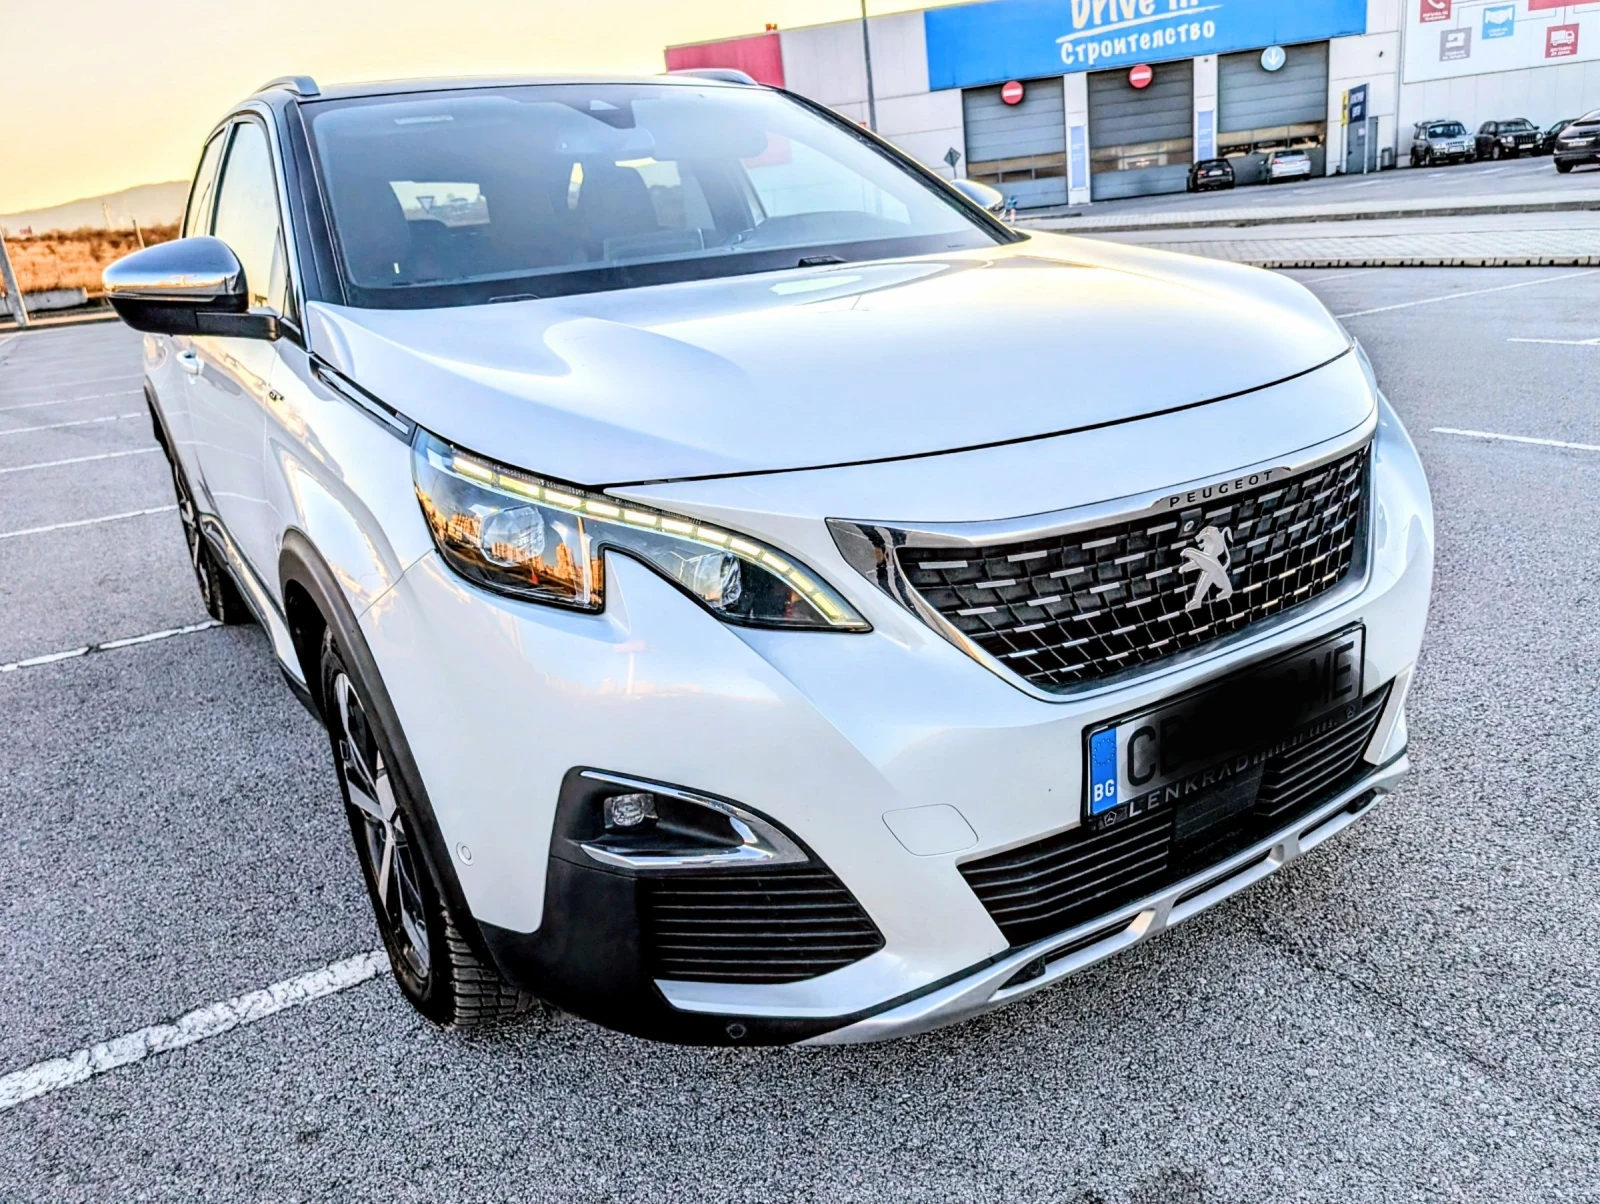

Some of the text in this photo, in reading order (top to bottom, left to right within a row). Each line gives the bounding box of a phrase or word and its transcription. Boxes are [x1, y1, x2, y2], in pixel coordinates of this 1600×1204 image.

[1060, 20, 1216, 65] Строителство
[1169, 470, 1273, 508] PEUGEOT
[1094, 779, 1115, 802] BG
